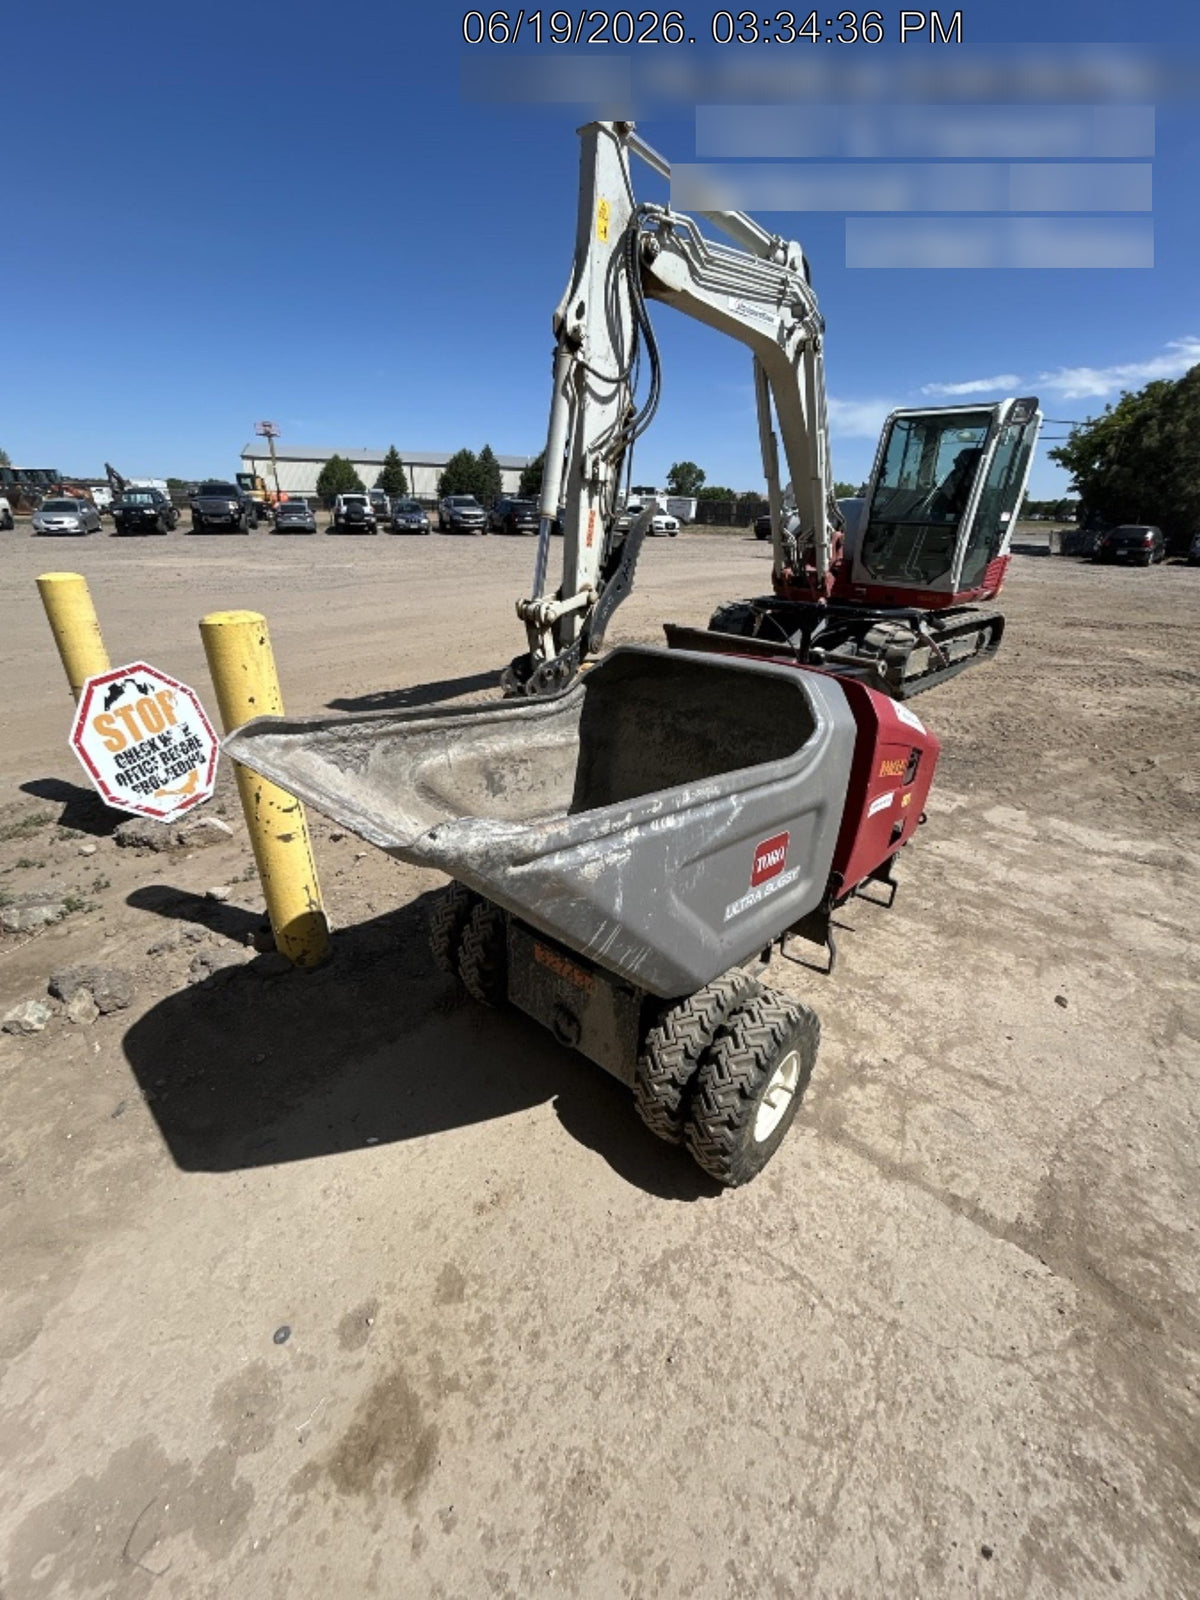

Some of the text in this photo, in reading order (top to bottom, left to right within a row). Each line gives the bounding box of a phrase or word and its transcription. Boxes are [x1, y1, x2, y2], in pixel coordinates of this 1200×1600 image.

[92, 689, 179, 752] STOP
[114, 736, 161, 769] CHECK
[115, 734, 204, 787] OFFICE BEFORE
